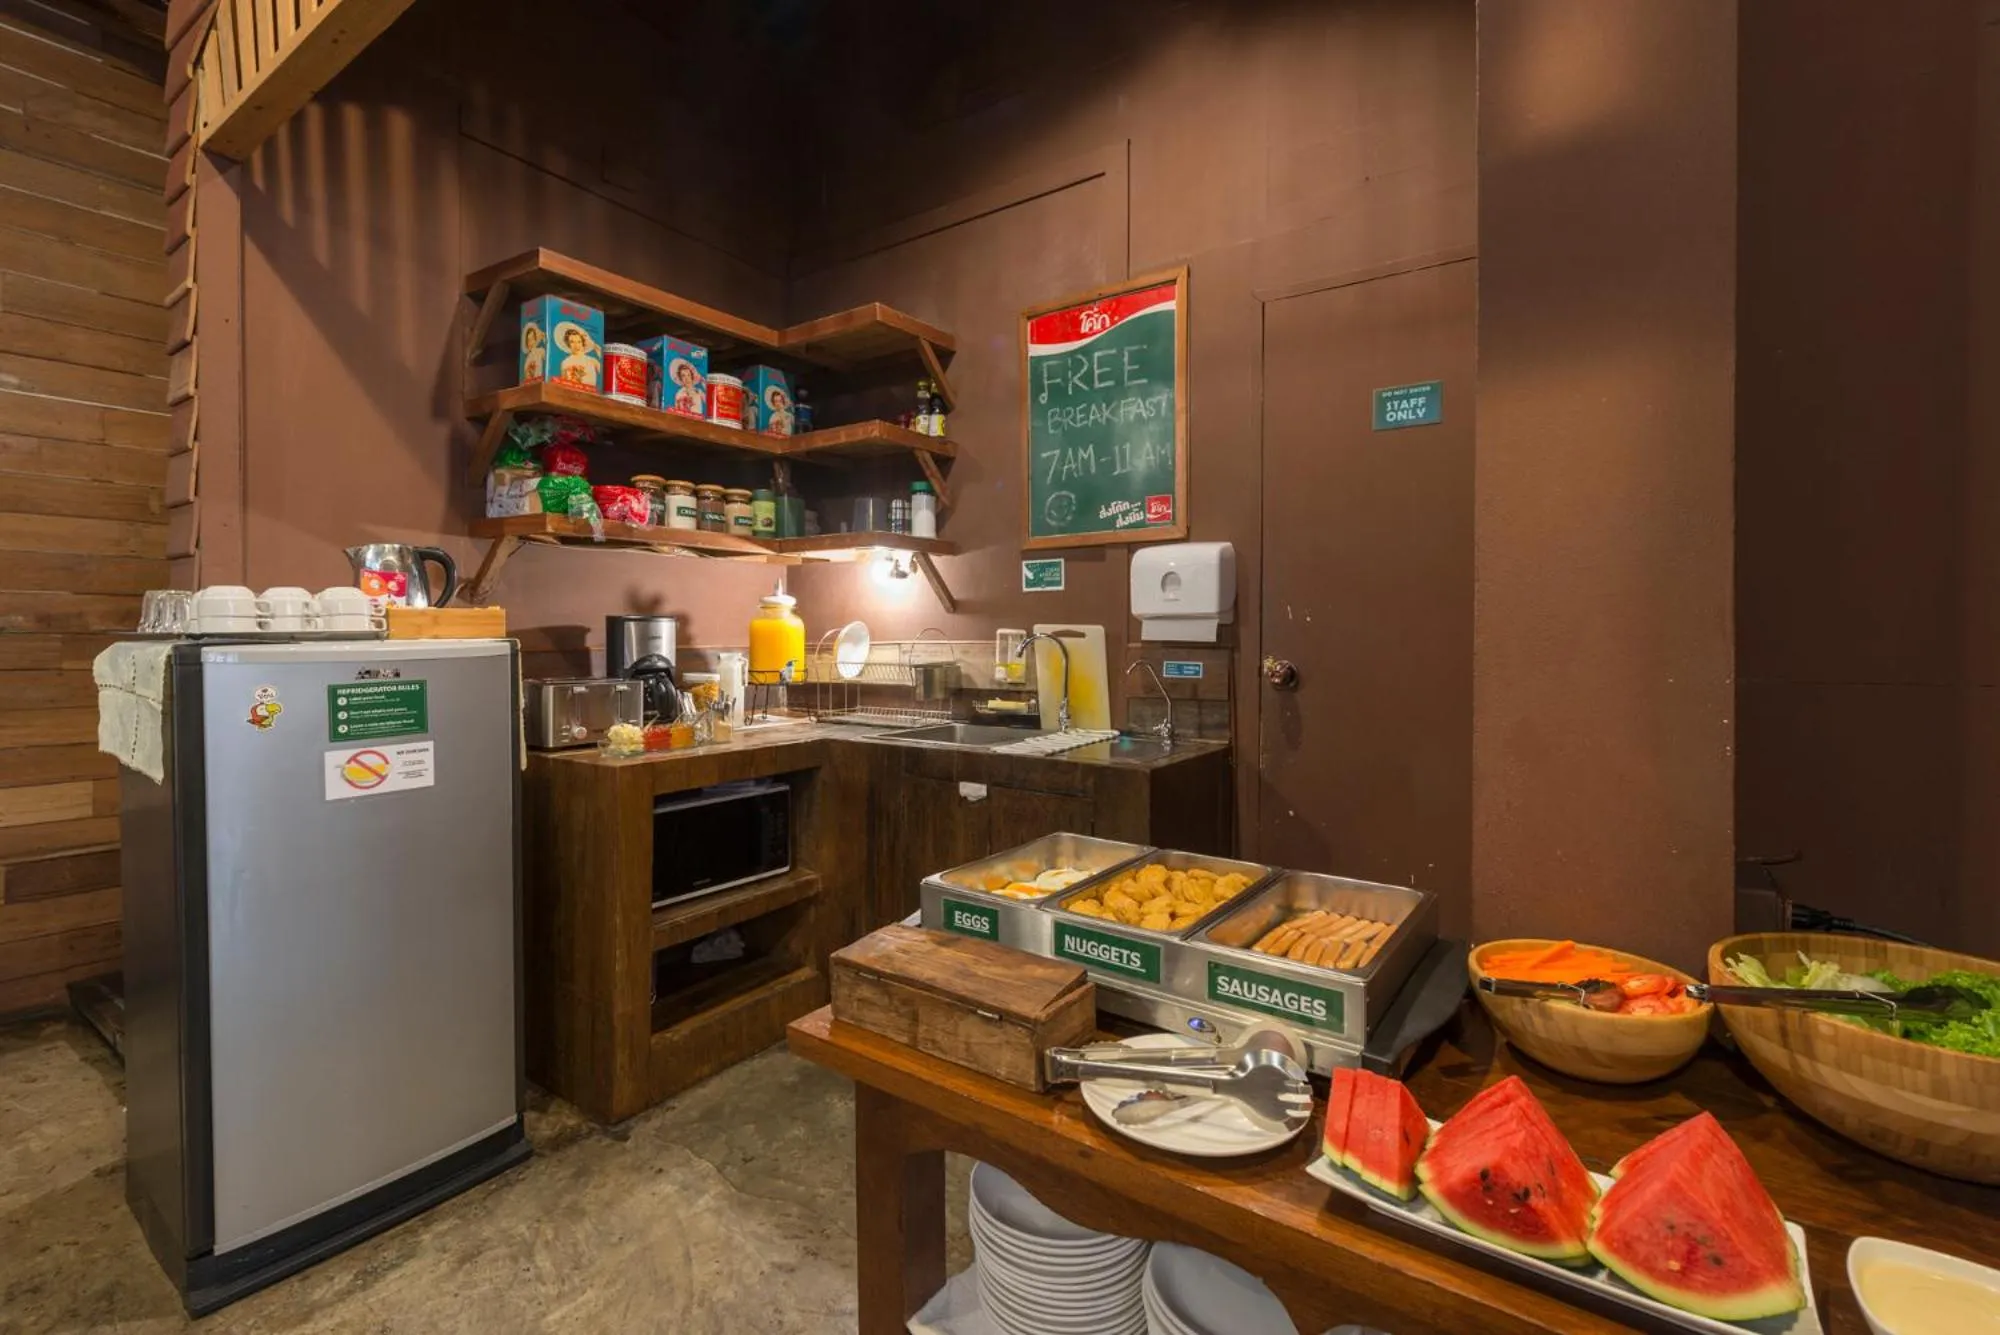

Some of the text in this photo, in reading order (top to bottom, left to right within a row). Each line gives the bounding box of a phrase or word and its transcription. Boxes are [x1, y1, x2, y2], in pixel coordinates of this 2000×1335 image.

[1038, 344, 1149, 404] FREE
[1047, 393, 1169, 435] BREAKFAST
[1386, 397, 1426, 412] STAFF
[1386, 408, 1426, 422] ONLY
[398, 684, 420, 692] RULES
[953, 909, 991, 933] EGGS
[1063, 933, 1142, 968] NUGGETS
[1216, 974, 1327, 1017] SAUSAGES
